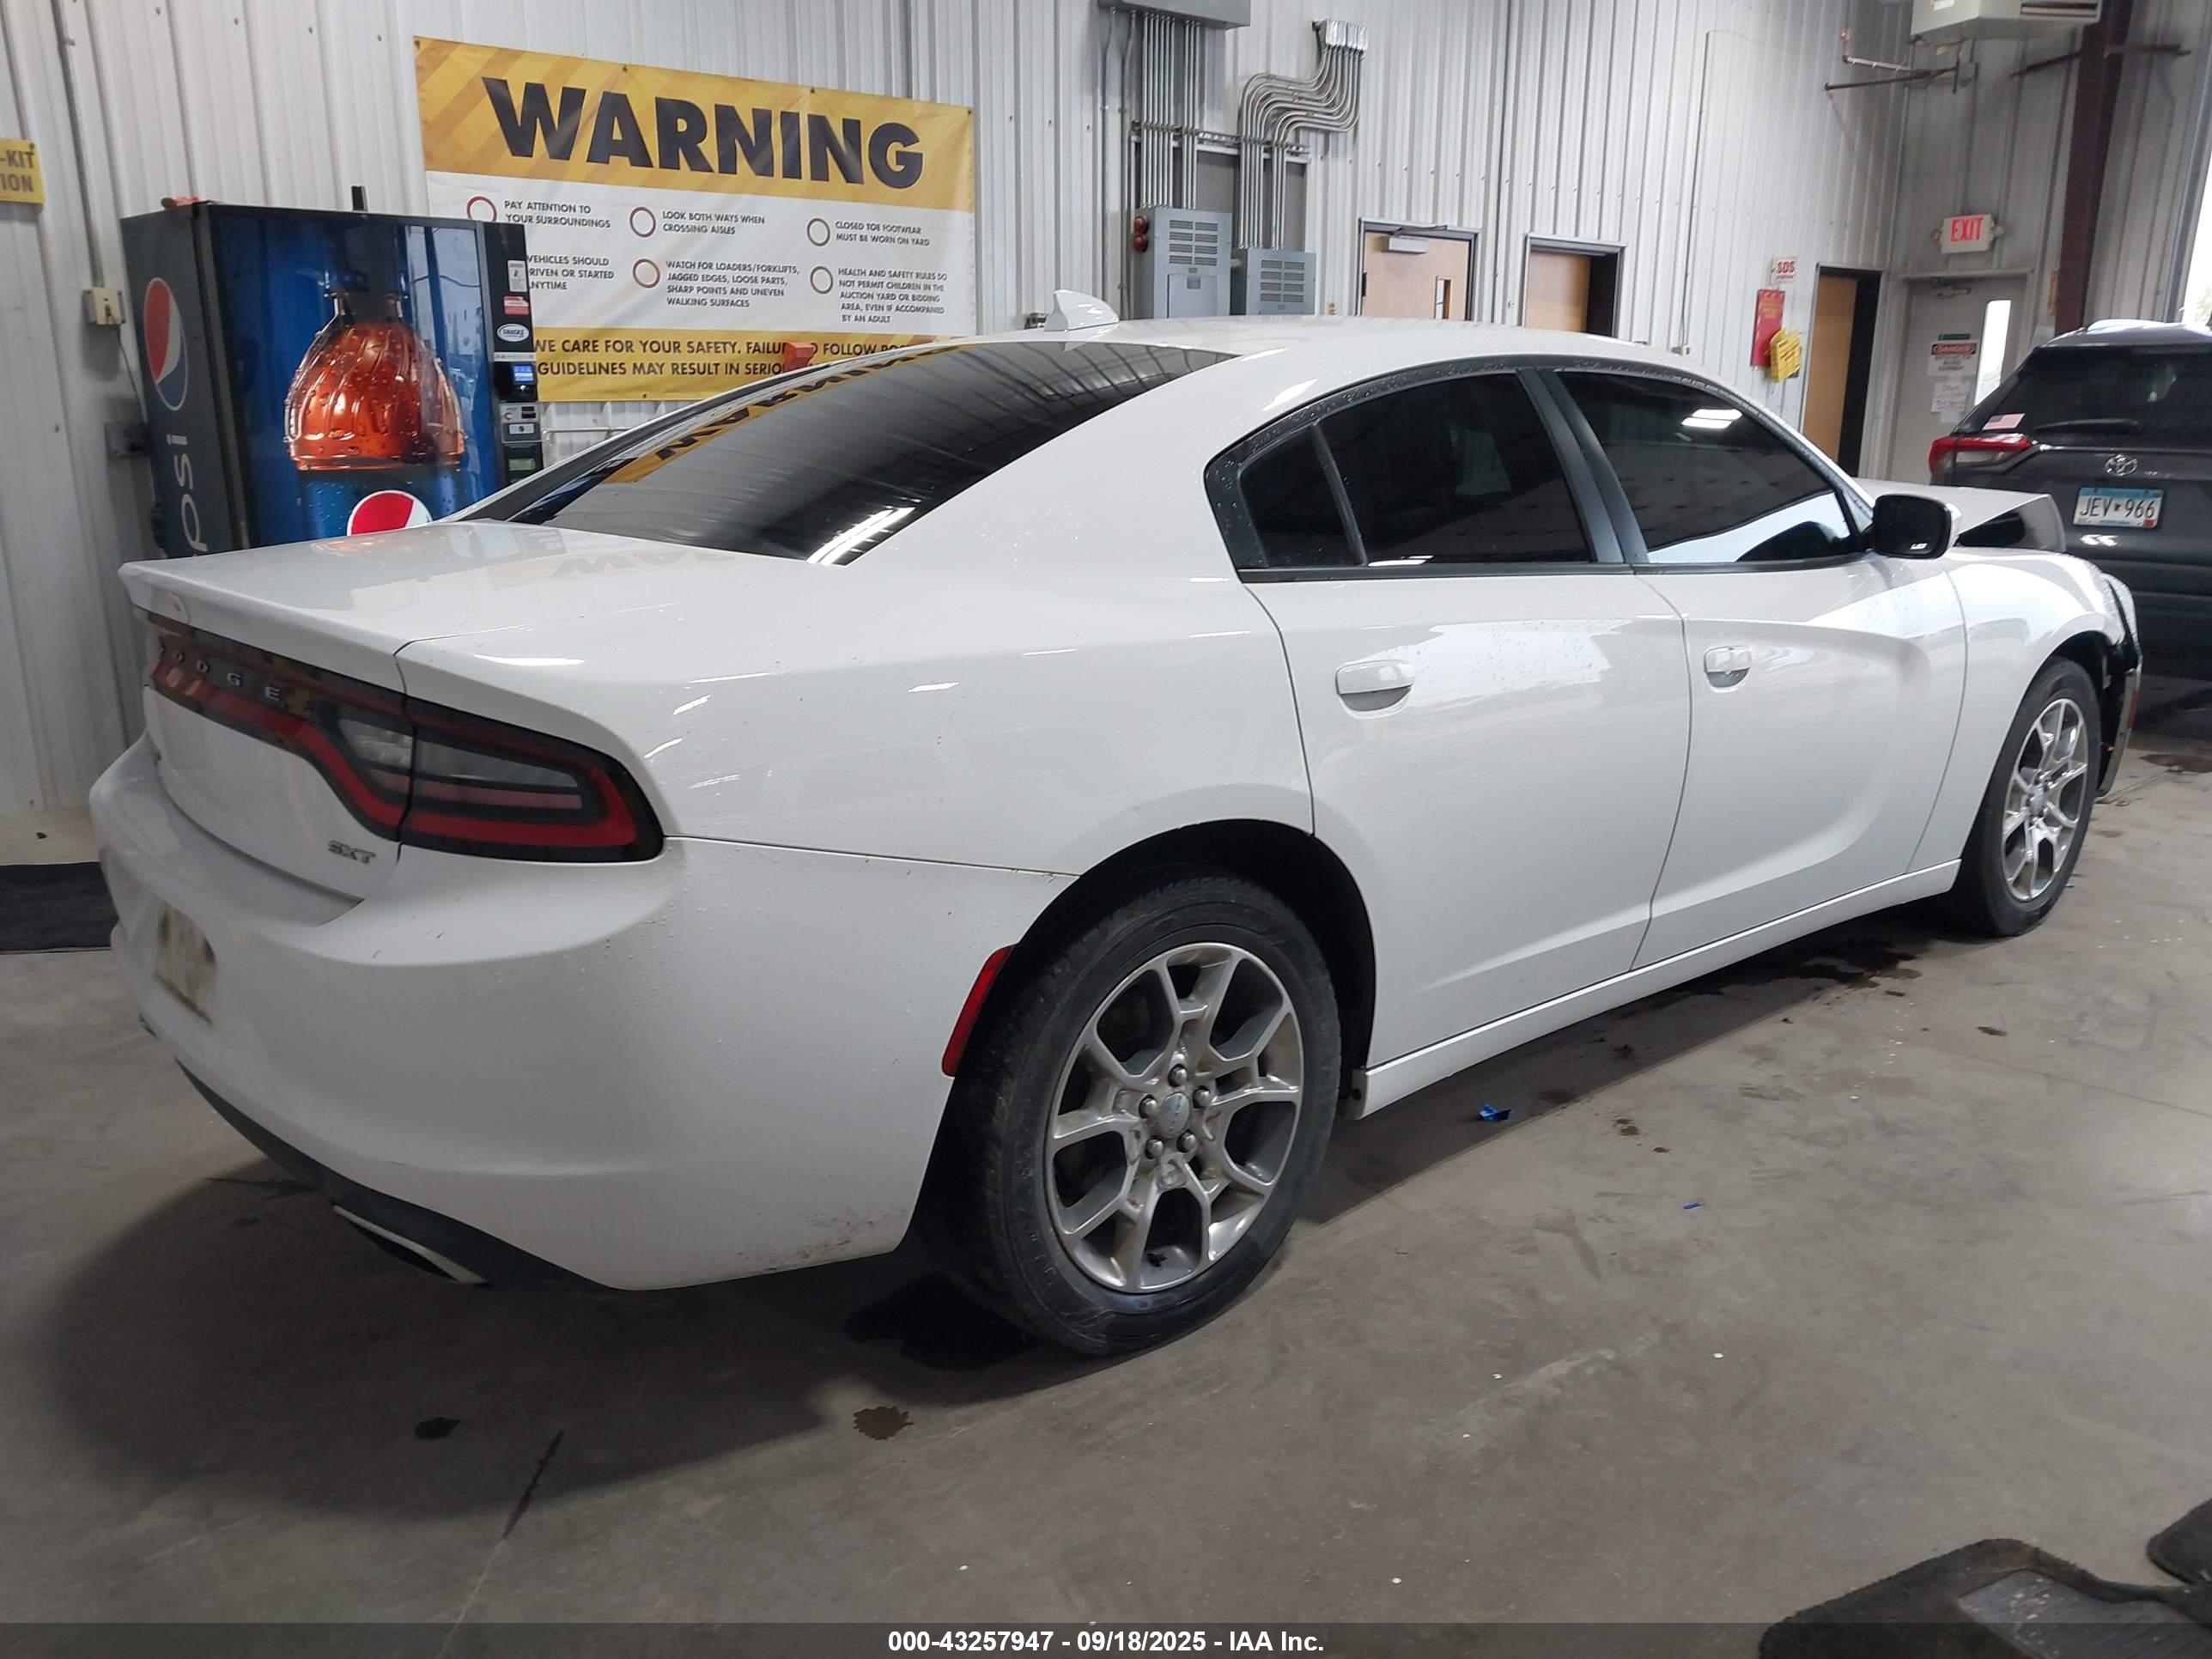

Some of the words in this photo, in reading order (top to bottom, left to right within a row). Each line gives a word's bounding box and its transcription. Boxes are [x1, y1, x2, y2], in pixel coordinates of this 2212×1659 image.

[482, 76, 924, 190] WARNING
[504, 200, 523, 210] PAY
[527, 202, 576, 213] ATTENTION
[580, 205, 591, 214] TO
[506, 215, 533, 223] YOUR
[536, 216, 611, 228] SURROUNDINGS
[663, 210, 686, 220] LOOK
[689, 212, 713, 222] BOTH
[714, 214, 738, 223] WAYS
[740, 215, 765, 224] WHEN
[663, 223, 708, 234] CROSSING
[711, 225, 736, 235] AISLES
[835, 221, 864, 230] CLOSED
[866, 222, 881, 232] TOE
[882, 224, 922, 234] FOOTWEAR
[1950, 216, 1984, 242] EXIT
[836, 233, 857, 241] MUST
[870, 235, 896, 244] WORN
[897, 236, 909, 245] ON
[911, 237, 930, 246] YARD
[526, 254, 569, 265] VEHICLES
[572, 257, 609, 266] SHOULD
[529, 268, 558, 277] RIVEN
[562, 269, 575, 277] OR
[578, 270, 615, 279] STARTED
[665, 260, 696, 270] WATCH
[716, 263, 800, 275] LOADERS/FORKLIFTS,
[838, 267, 866, 277] HEALTH
[868, 269, 886, 277] AND
[888, 270, 914, 279] SAFETY
[667, 272, 700, 282] JAGGED
[701, 274, 730, 284] EDGES,
[732, 275, 759, 284] LOOSE
[761, 276, 788, 286] PARTS,
[839, 280, 855, 289] NOT
[858, 280, 884, 289] PERMIT
[885, 282, 921, 291] CHILDREN
[922, 283, 931, 291] IN
[667, 284, 694, 294] SHARP
[696, 286, 727, 295] POINTS
[730, 287, 749, 296] AND
[750, 288, 785, 297] UNEVEN
[840, 291, 874, 301] AUCTION
[876, 292, 896, 301] YARD
[898, 293, 909, 301] OR
[666, 296, 708, 307] WALKING
[709, 298, 750, 307] SURFACES
[841, 303, 863, 313] AREA,
[886, 304, 893, 313] IF
[842, 314, 852, 323] BY
[854, 314, 866, 323] AN
[867, 315, 891, 324] ADULT
[534, 339, 556, 353] WE
[562, 339, 599, 353] CARE
[605, 339, 635, 354] FOR
[640, 340, 682, 354] YOUR
[686, 341, 742, 355] SAFETY.
[745, 342, 787, 355] FAILU
[823, 343, 878, 356] FOLLOW
[538, 362, 627, 376] GUIDELINES
[632, 362, 665, 375] MAY
[671, 362, 720, 375] RESULT
[724, 362, 740, 375] IN
[744, 362, 786, 375] SERIO
[166, 434, 209, 559] psi
[328, 839, 377, 864] SXT
